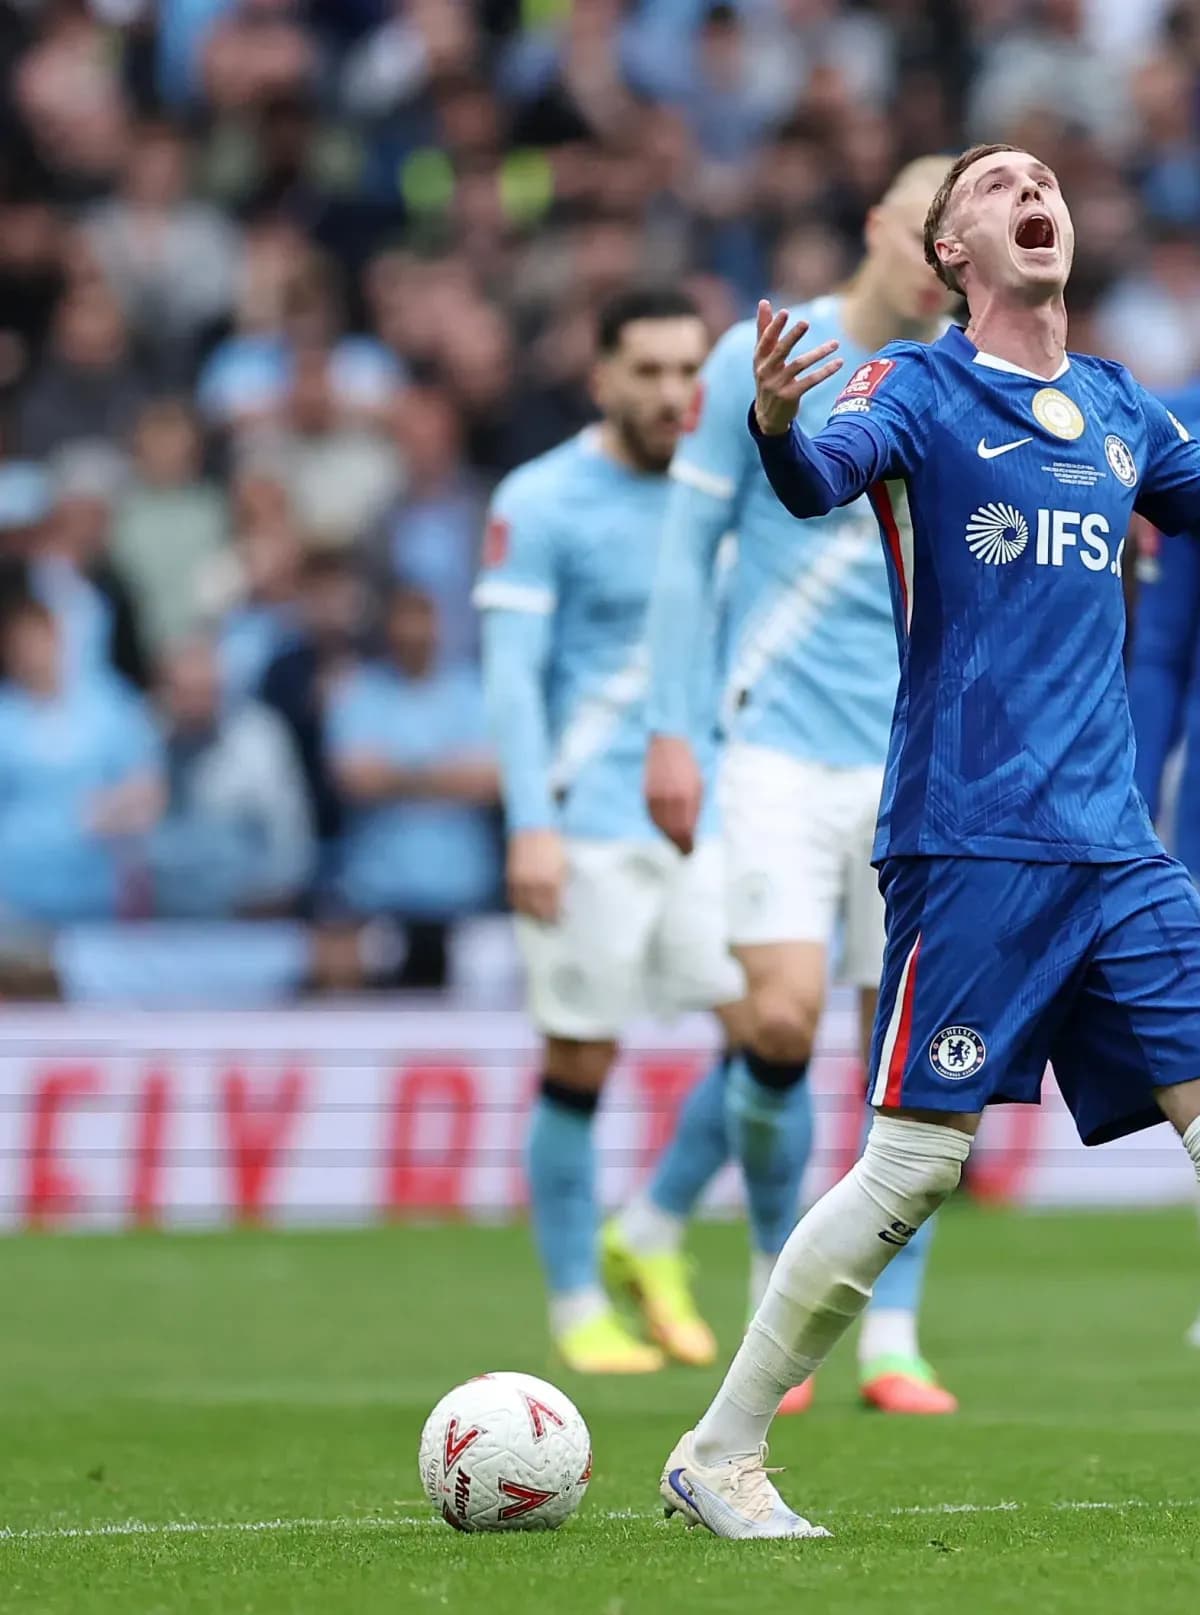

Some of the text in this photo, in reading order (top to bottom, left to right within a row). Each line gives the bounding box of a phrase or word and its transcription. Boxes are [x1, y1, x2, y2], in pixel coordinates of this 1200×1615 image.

[1036, 508, 1125, 578] IFS.
[940, 1028, 977, 1041] CHELSEA
[455, 1466, 471, 1520] Mitre
